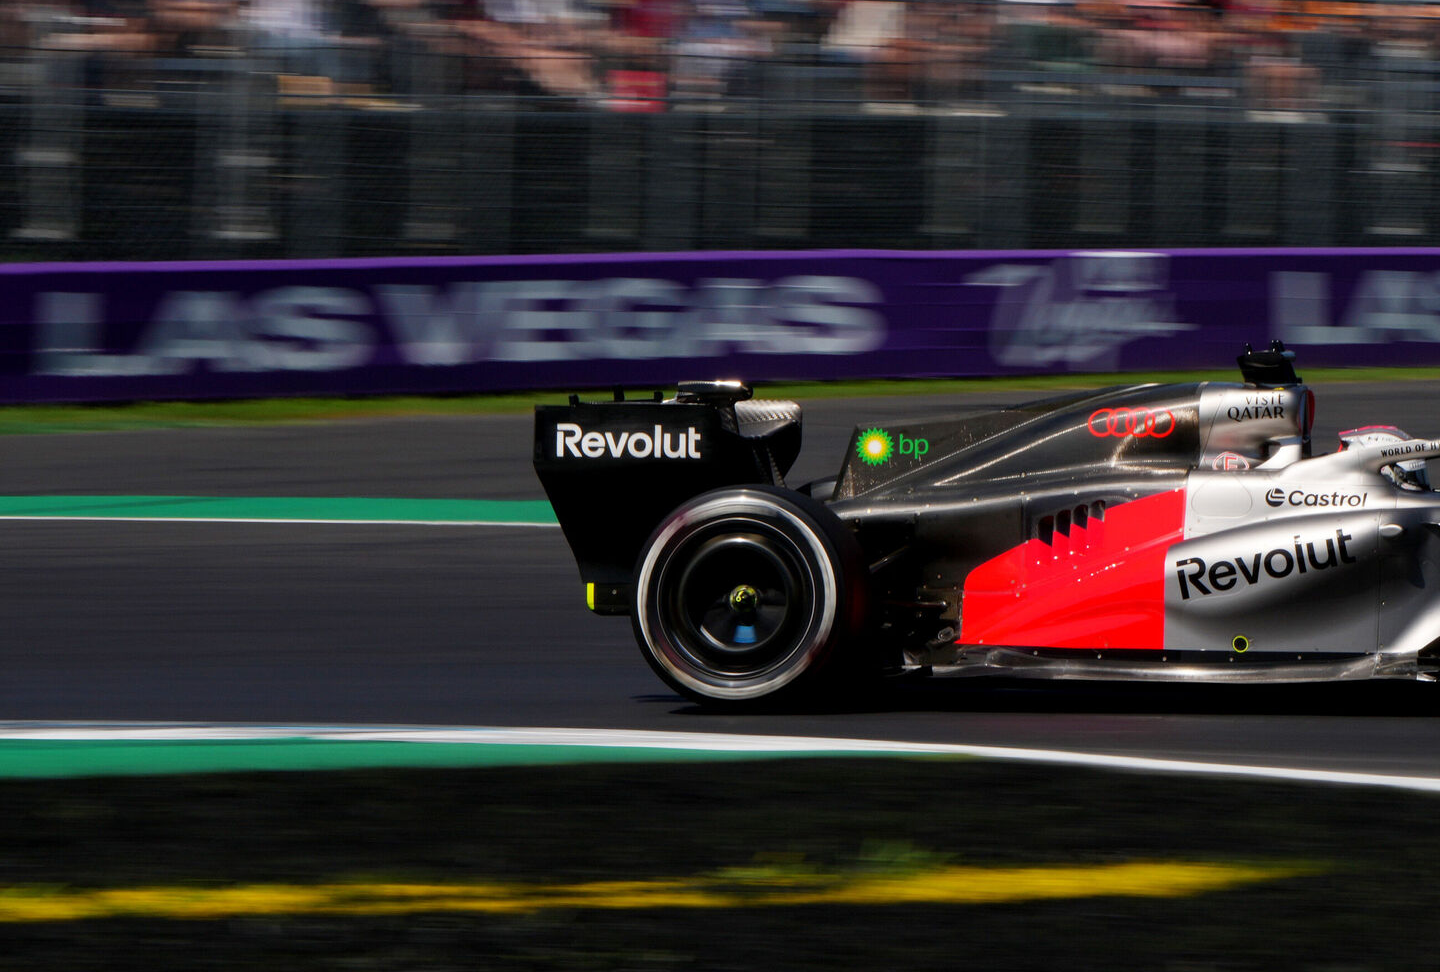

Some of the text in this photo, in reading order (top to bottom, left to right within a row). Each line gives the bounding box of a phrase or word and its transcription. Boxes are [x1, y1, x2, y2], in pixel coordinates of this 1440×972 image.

[34, 286, 372, 376] LAS
[378, 277, 886, 368] VEGAS
[1246, 392, 1284, 406] visit
[1227, 406, 1284, 422] QATAR
[556, 423, 701, 458] Revolut
[899, 434, 929, 459] bp
[1380, 446, 1412, 458] WORLD
[1415, 443, 1427, 452] OF
[1288, 490, 1368, 507] Castrol
[1175, 529, 1356, 600] Revolut
